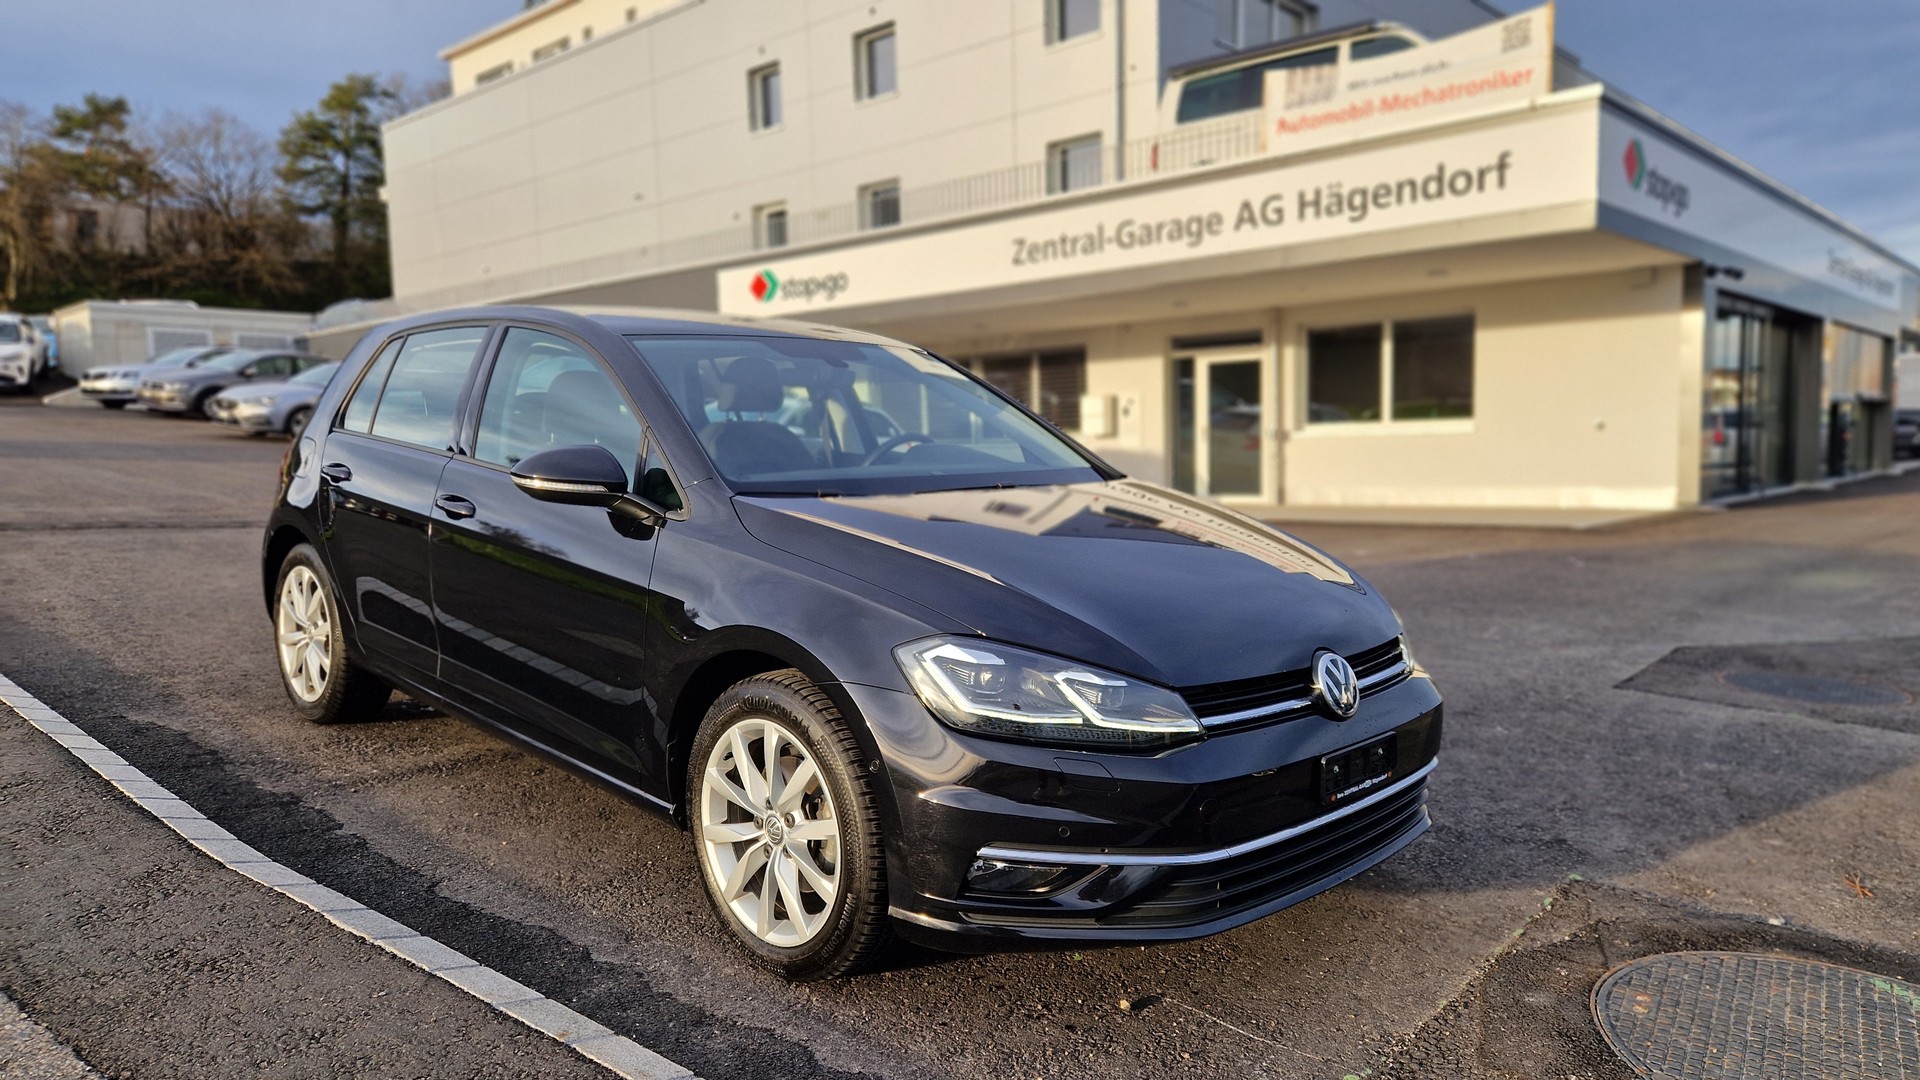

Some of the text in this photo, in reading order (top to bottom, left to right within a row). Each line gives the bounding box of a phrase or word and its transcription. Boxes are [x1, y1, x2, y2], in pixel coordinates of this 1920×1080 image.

[1275, 67, 1534, 136] Automobil-Mechatroniker
[1010, 150, 1514, 267] Zentral-Garage AG Hägendorf
